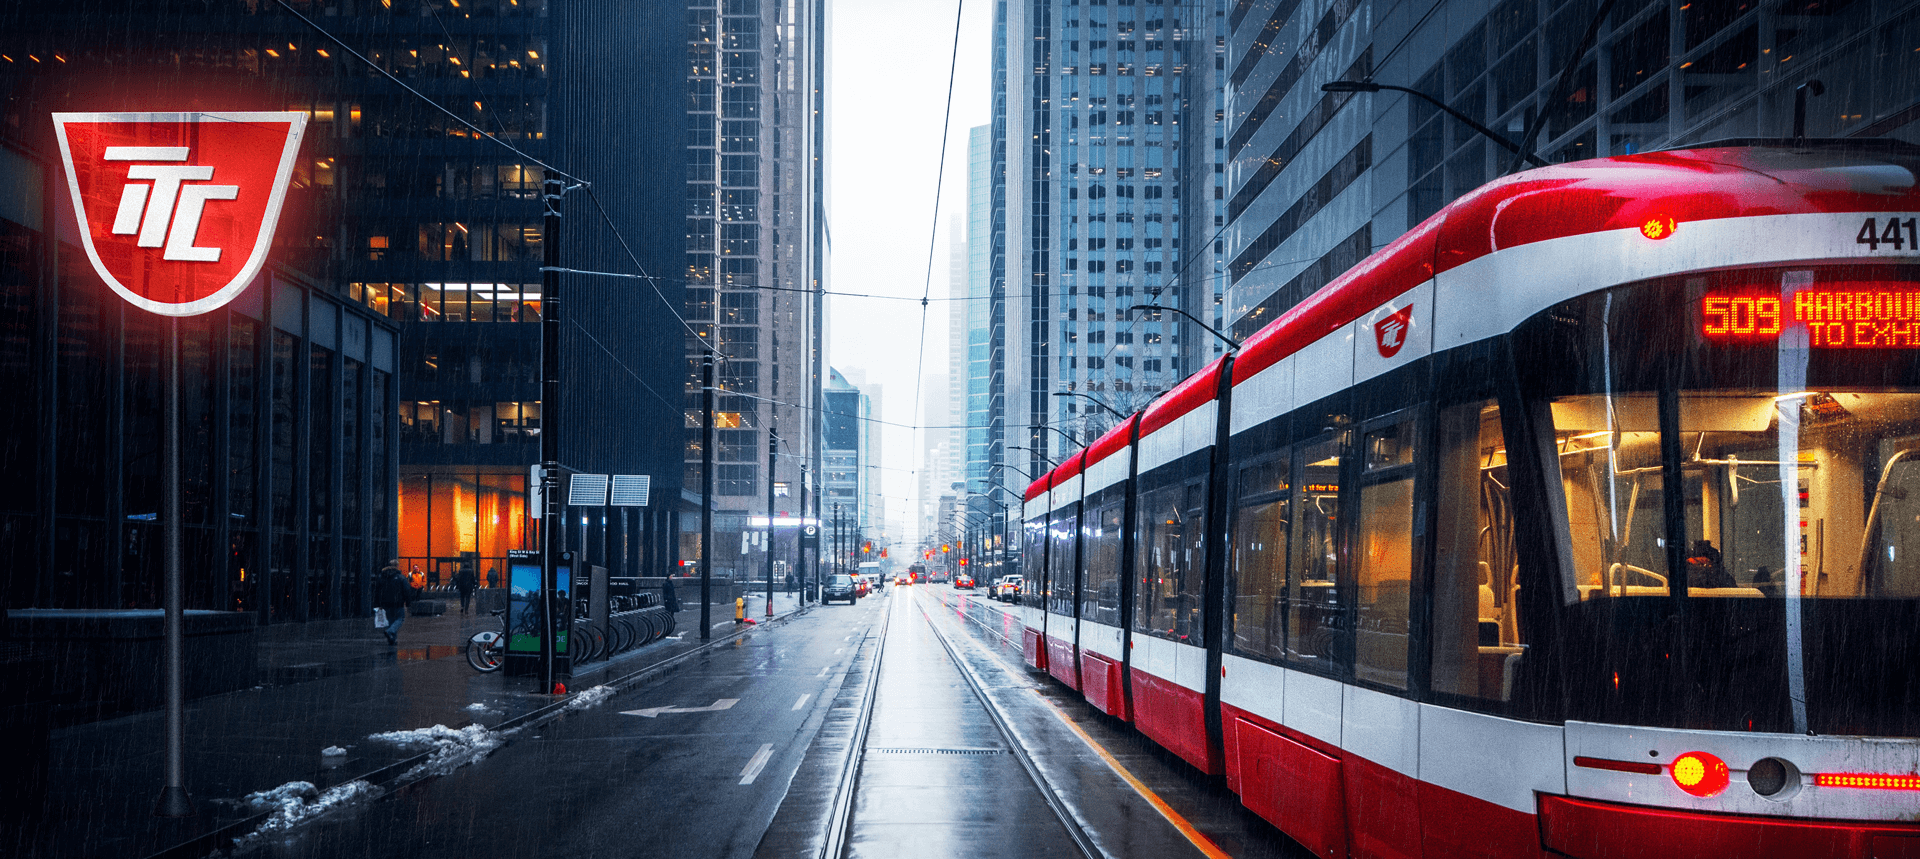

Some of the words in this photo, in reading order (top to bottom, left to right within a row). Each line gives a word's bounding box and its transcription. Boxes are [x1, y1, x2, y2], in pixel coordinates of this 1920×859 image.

[103, 146, 240, 262] TTC
[1705, 296, 1780, 334] 509
[1380, 319, 1404, 348] TTC
[1809, 322, 1844, 345] TO
